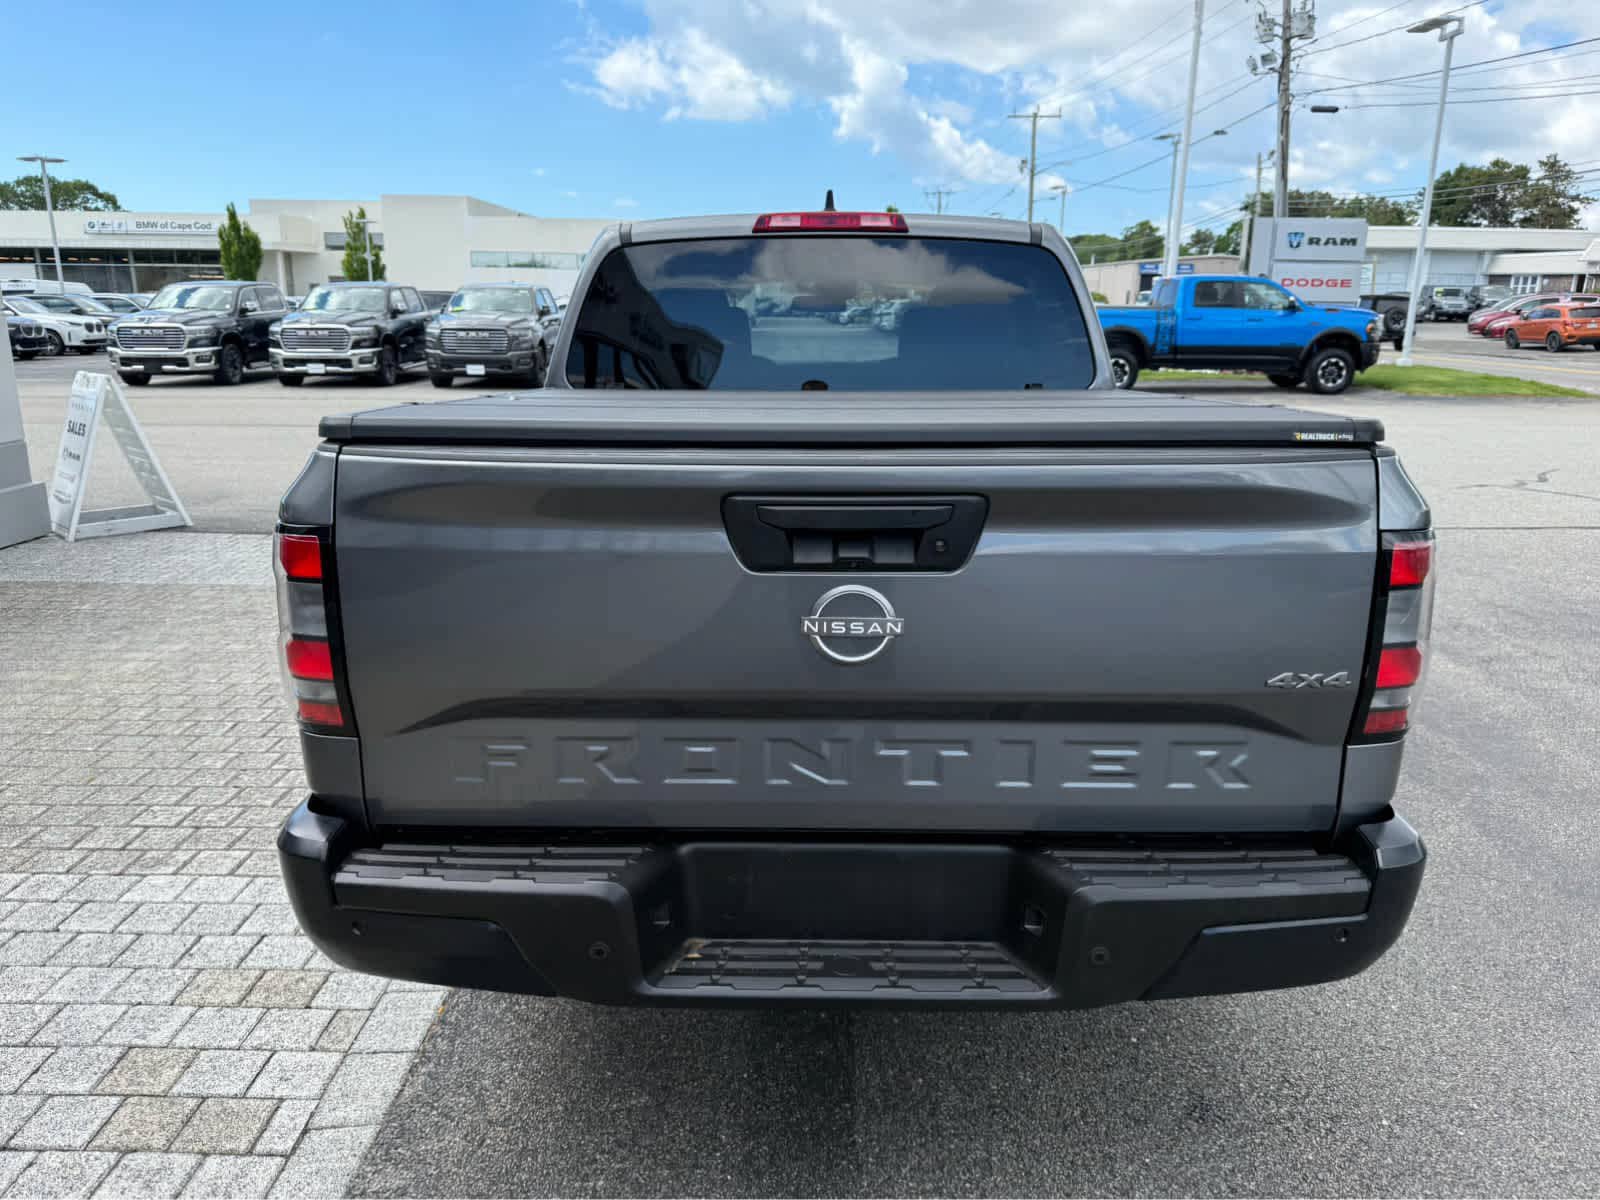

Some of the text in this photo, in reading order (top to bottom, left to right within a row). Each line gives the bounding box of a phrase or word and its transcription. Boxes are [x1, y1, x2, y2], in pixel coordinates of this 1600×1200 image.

[135, 220, 212, 232] BMW of Cape Cod
[1307, 236, 1358, 247] RAM
[1281, 278, 1353, 288] DODGE
[67, 420, 86, 436] SALES
[803, 620, 902, 633] NISSAN
[453, 736, 1251, 788] FRONTIER
